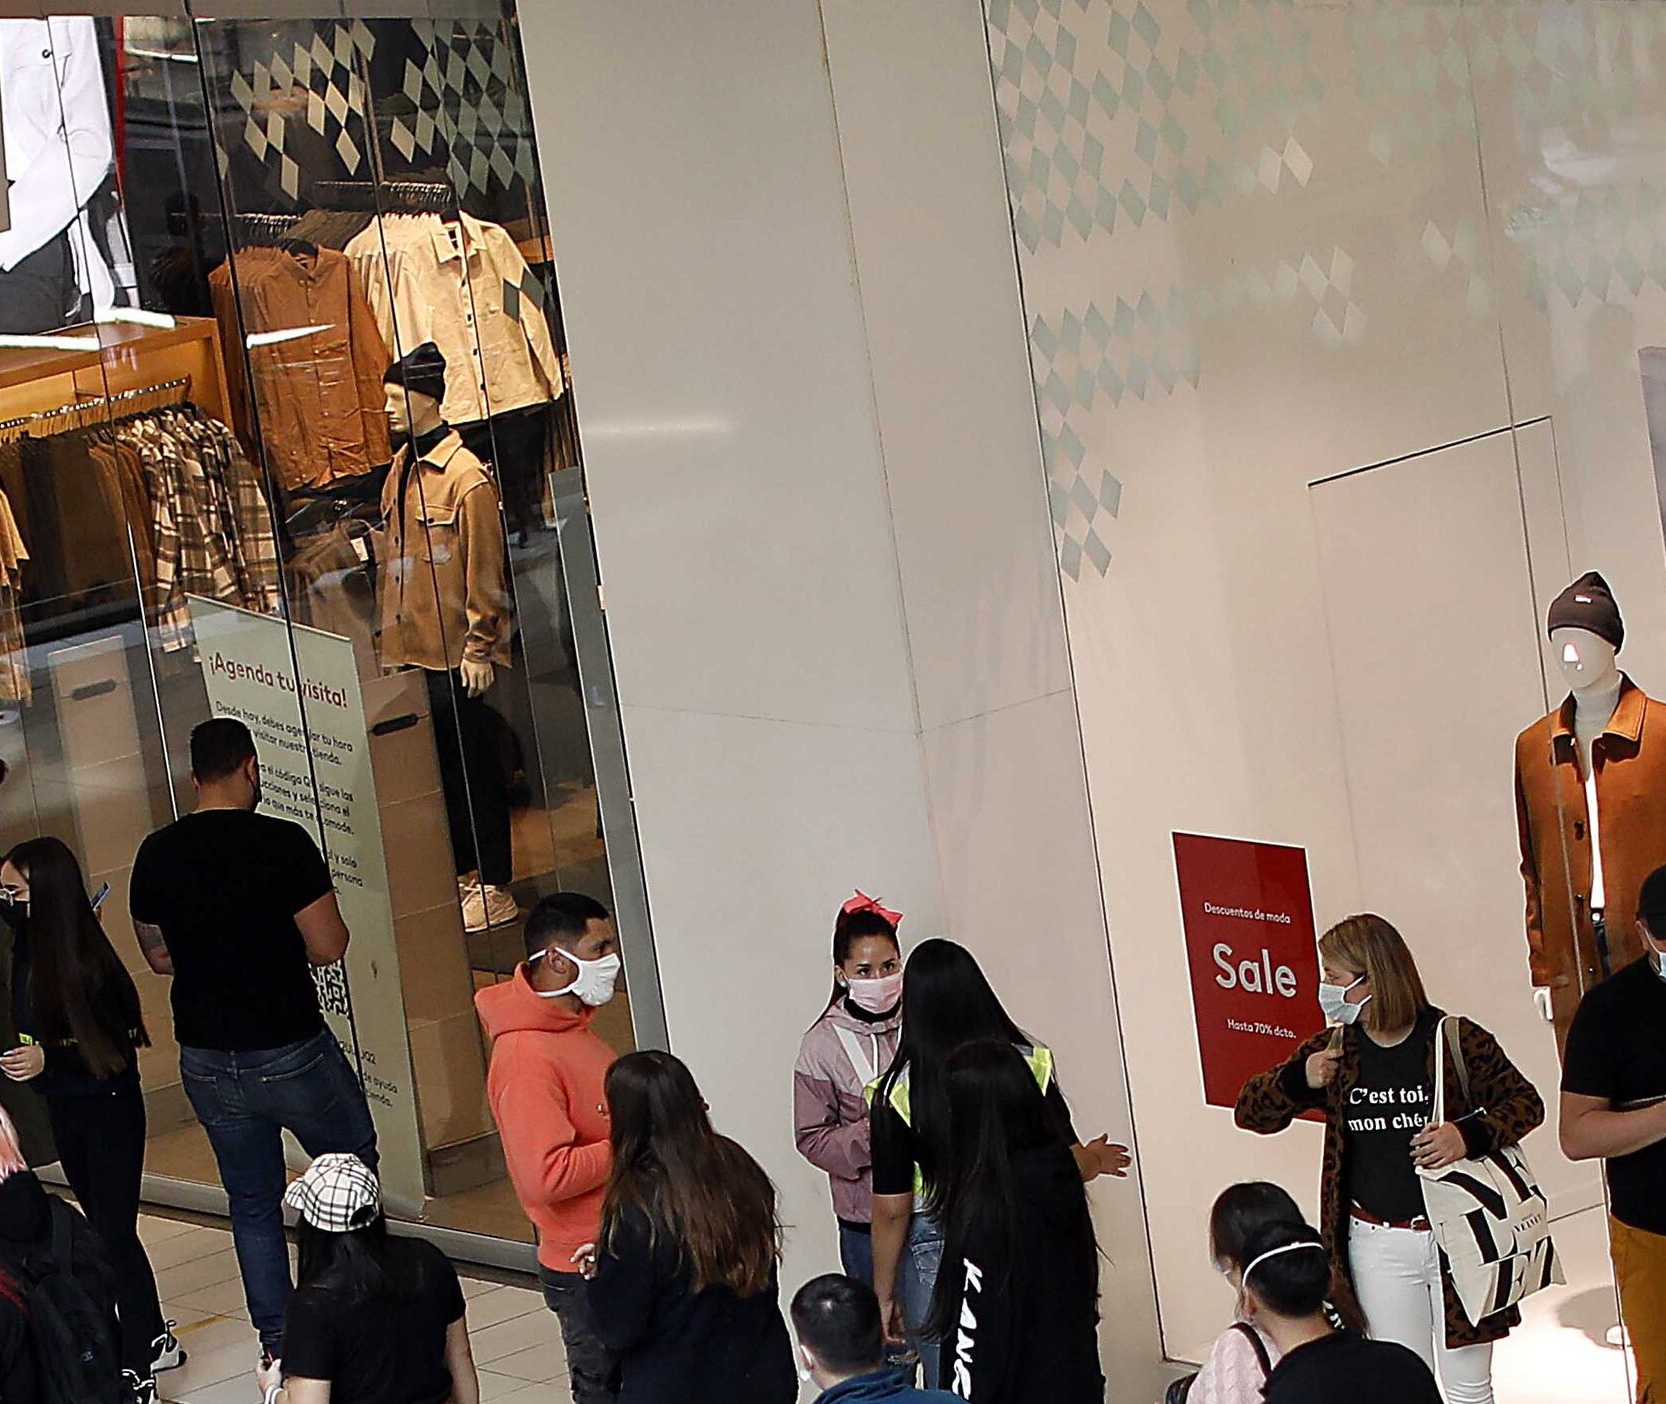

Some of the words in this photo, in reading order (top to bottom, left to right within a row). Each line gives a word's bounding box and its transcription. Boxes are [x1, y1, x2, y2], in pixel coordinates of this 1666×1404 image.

[209, 652, 274, 687] ¡Agenda
[277, 671, 295, 692] tu
[1204, 902, 1253, 919] Descuentos
[1255, 909, 1265, 920] de
[1266, 913, 1291, 924] moda
[1213, 943, 1297, 998] Sale
[1227, 1019, 1253, 1033] Hasta
[1254, 1022, 1273, 1035] 70%
[1350, 1087, 1395, 1104] C'est
[1348, 1117, 1387, 1131] mon
